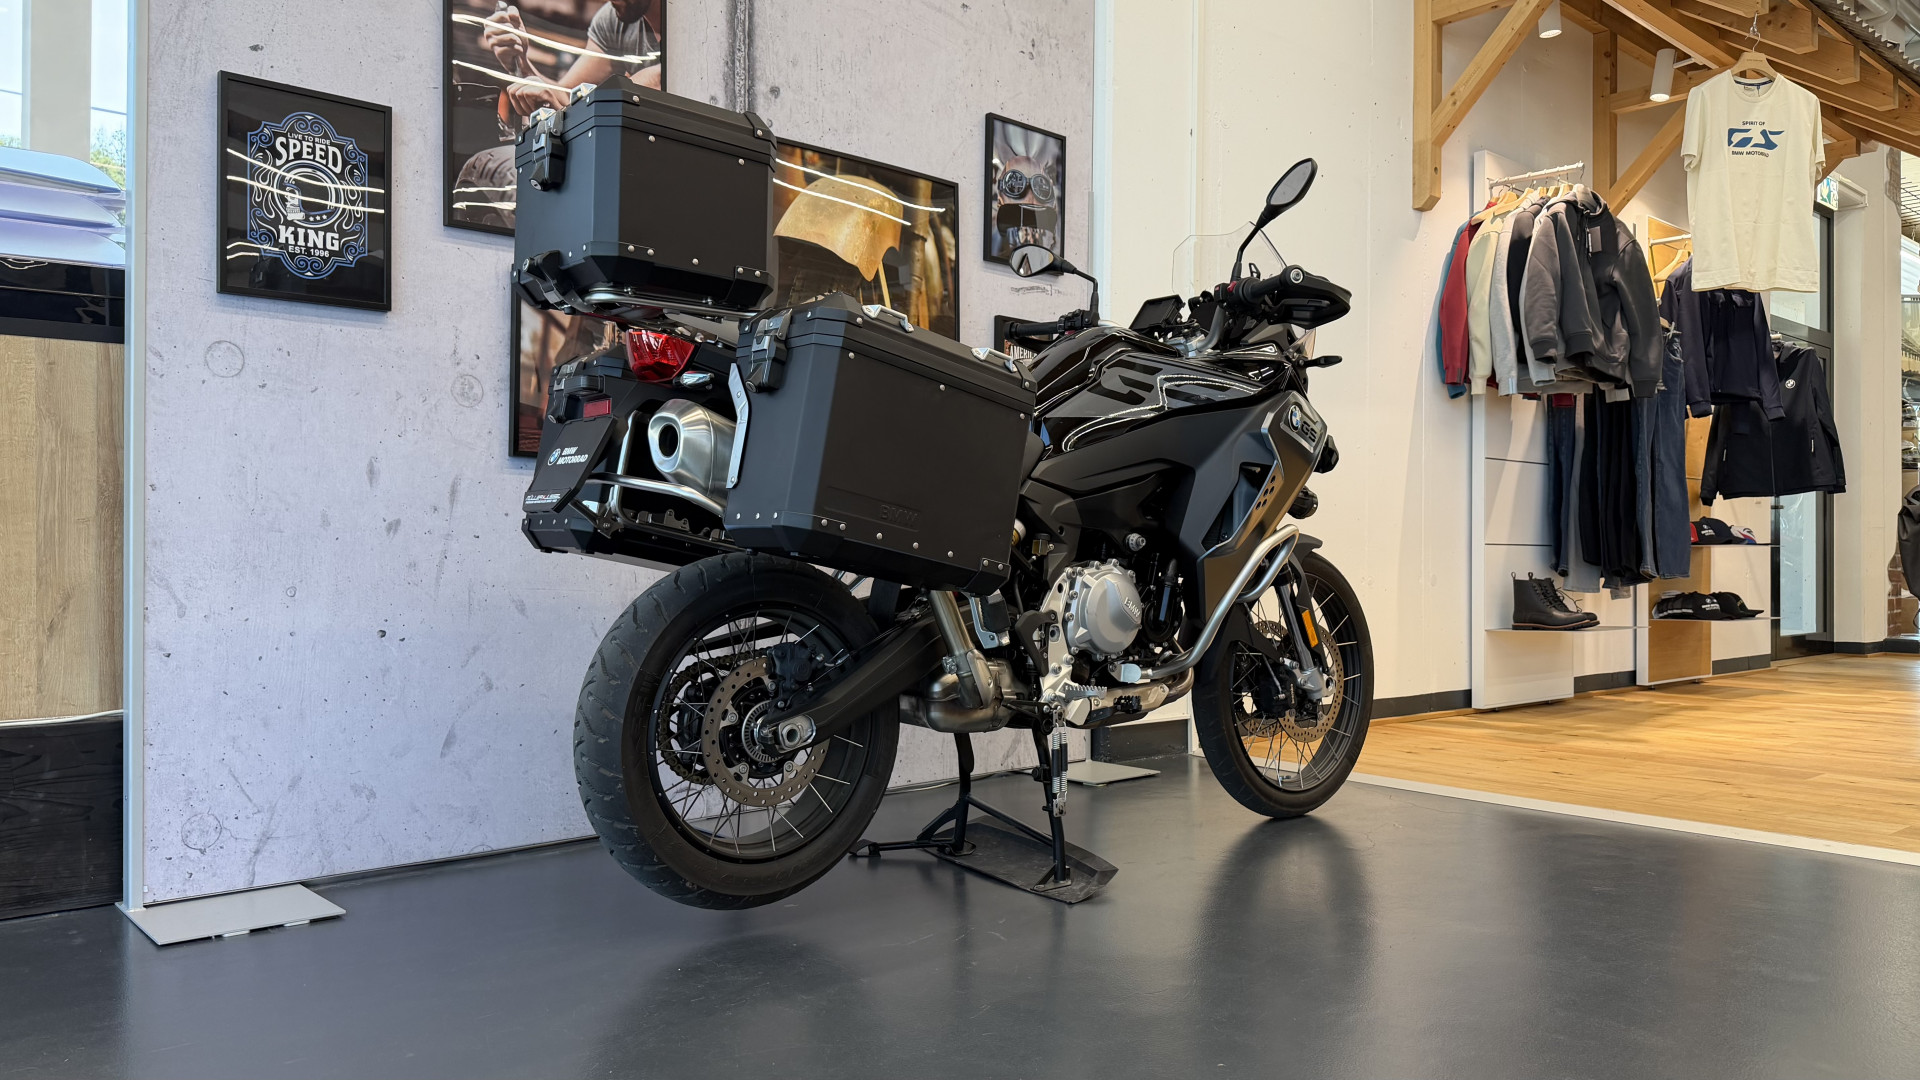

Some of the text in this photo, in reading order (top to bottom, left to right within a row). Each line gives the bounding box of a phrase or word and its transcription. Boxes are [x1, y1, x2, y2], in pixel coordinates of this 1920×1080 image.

[287, 132, 303, 140] LIVE
[314, 137, 331, 145] RIDE
[1728, 128, 1784, 150] GS
[275, 136, 342, 174] SPEED
[279, 225, 339, 251] KING
[288, 245, 330, 258] EST. 1996
[1301, 420, 1317, 442] GS
[556, 454, 589, 465] MOTORRAD
[562, 446, 579, 455] BMW
[880, 504, 918, 526] BMW
[1124, 596, 1141, 617] BMW
